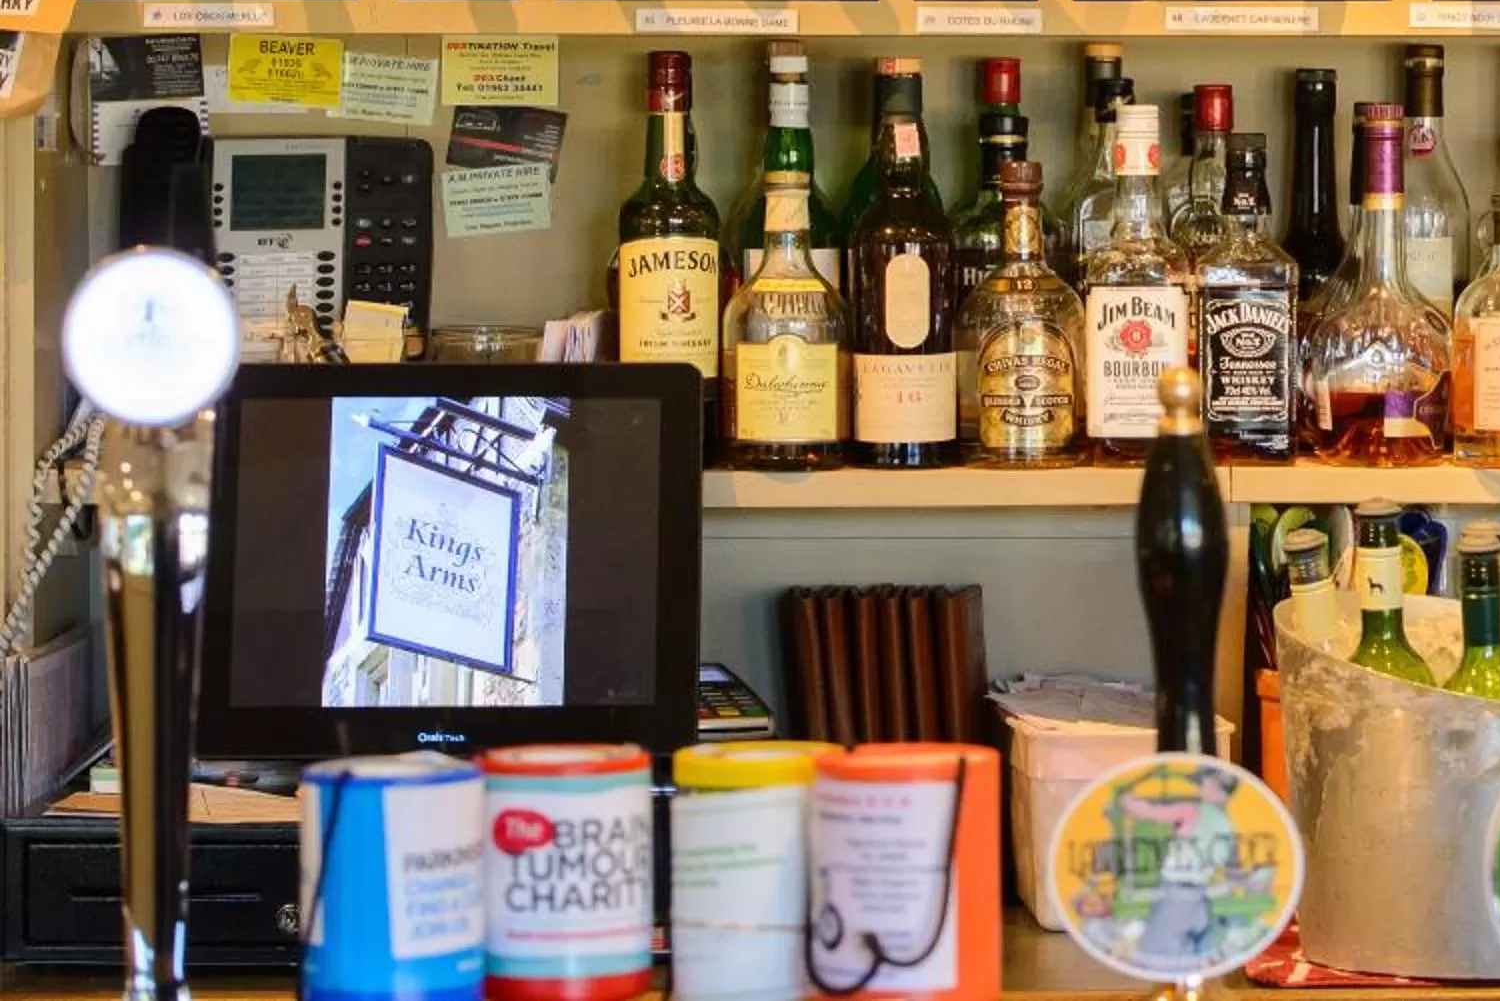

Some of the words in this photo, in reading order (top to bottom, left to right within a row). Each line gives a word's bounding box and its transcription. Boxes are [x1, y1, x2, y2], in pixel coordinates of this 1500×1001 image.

[259, 40, 315, 56] BEAVER
[629, 250, 717, 278] JAMESON
[1015, 279, 1033, 291] 12
[1097, 302, 1128, 330] JIM
[1131, 296, 1176, 329] BEAM
[1206, 304, 1240, 334] JACK
[405, 517, 484, 568] Kings
[403, 554, 480, 594] Arms
[502, 816, 544, 841] The
